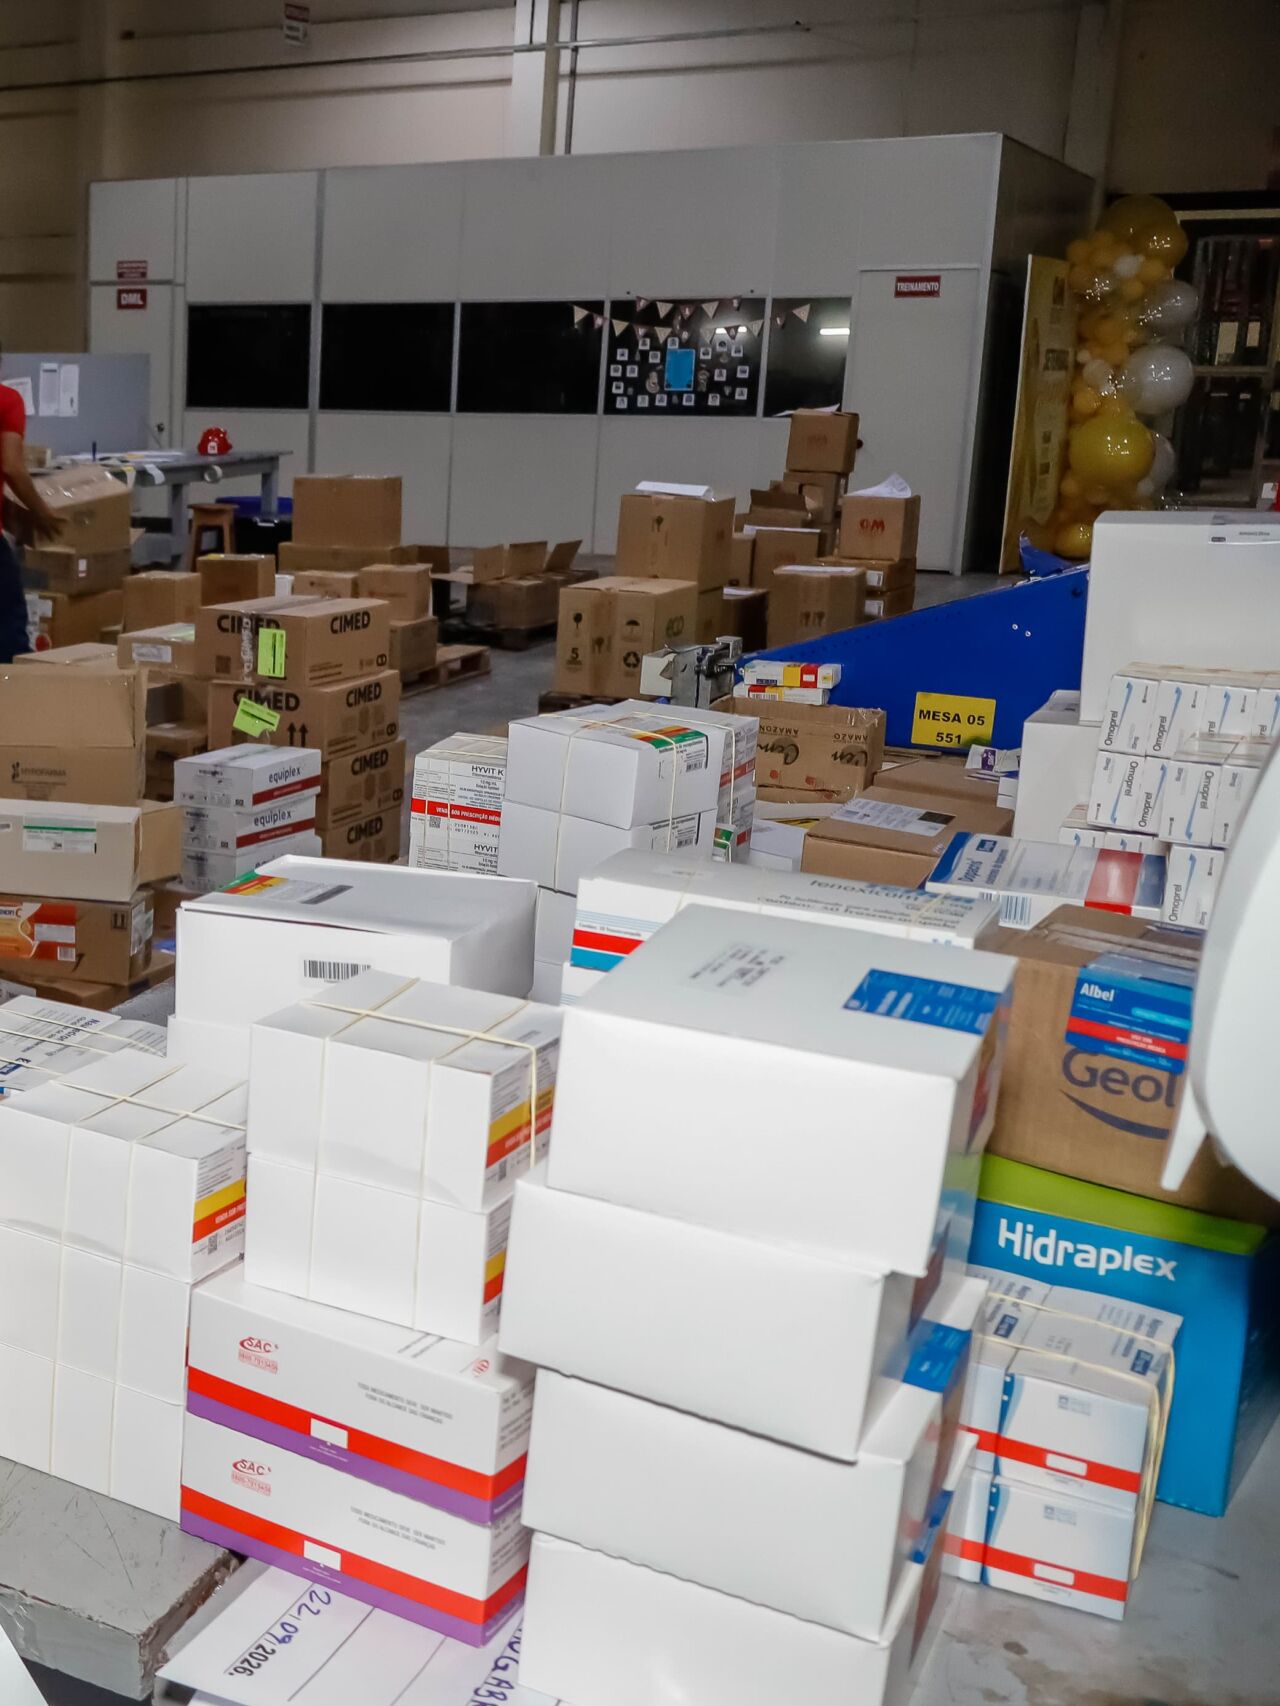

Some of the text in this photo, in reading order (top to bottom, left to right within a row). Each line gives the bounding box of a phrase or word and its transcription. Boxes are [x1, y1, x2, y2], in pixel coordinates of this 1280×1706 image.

[330, 611, 371, 635] CIMED
[346, 681, 382, 708] CIMED
[918, 709, 985, 726] MESA 05
[1104, 710, 1119, 747] Omoprel
[935, 732, 962, 744] 551
[1152, 716, 1167, 752] Omoprel
[268, 765, 301, 784] equiplex
[351, 749, 389, 776] CIMED
[471, 765, 504, 777] HYVIT K
[1124, 761, 1139, 797] Omoprel
[1200, 770, 1215, 810] Omoprel
[254, 809, 292, 828] equiplex
[1138, 792, 1153, 828] Omoprel
[347, 816, 383, 844] CIMED
[473, 843, 498, 853] HYVIT
[1169, 884, 1182, 922] Omoprel
[1080, 982, 1115, 1002] Albel
[997, 1218, 1178, 1282] Hidraplex
[246, 1336, 272, 1353] SAC
[239, 1458, 265, 1476] SAC
